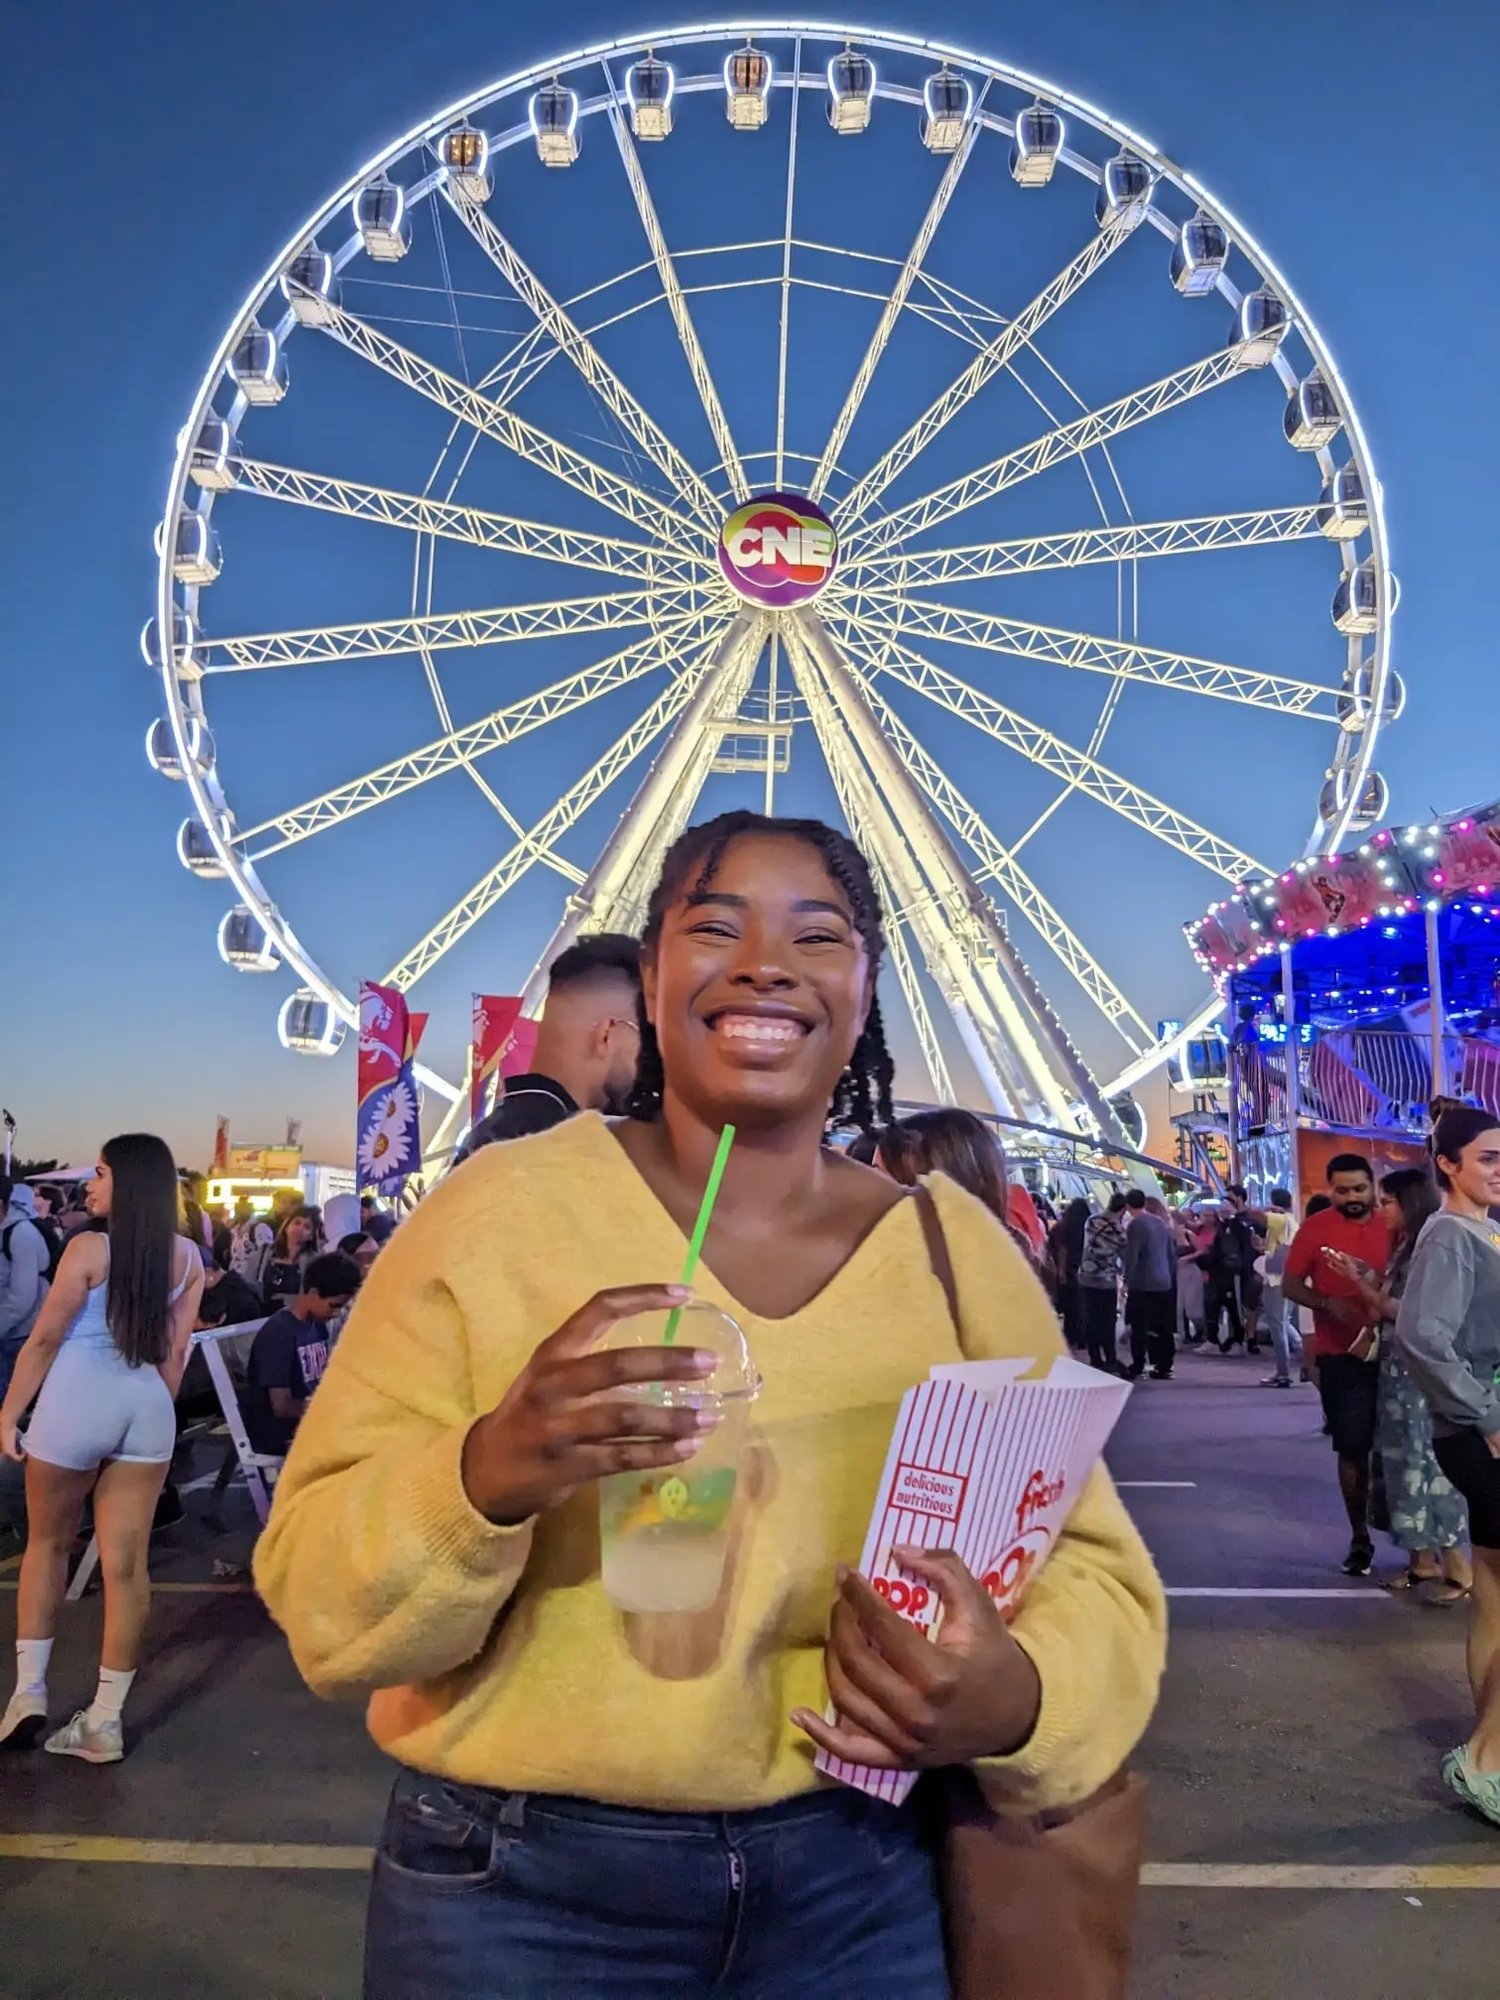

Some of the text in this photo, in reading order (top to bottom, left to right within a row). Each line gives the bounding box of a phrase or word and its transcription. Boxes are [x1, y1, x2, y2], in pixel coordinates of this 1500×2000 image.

[729, 526, 833, 567] CNE
[904, 1470, 955, 1497] delicious
[896, 1491, 953, 1514] nutritious
